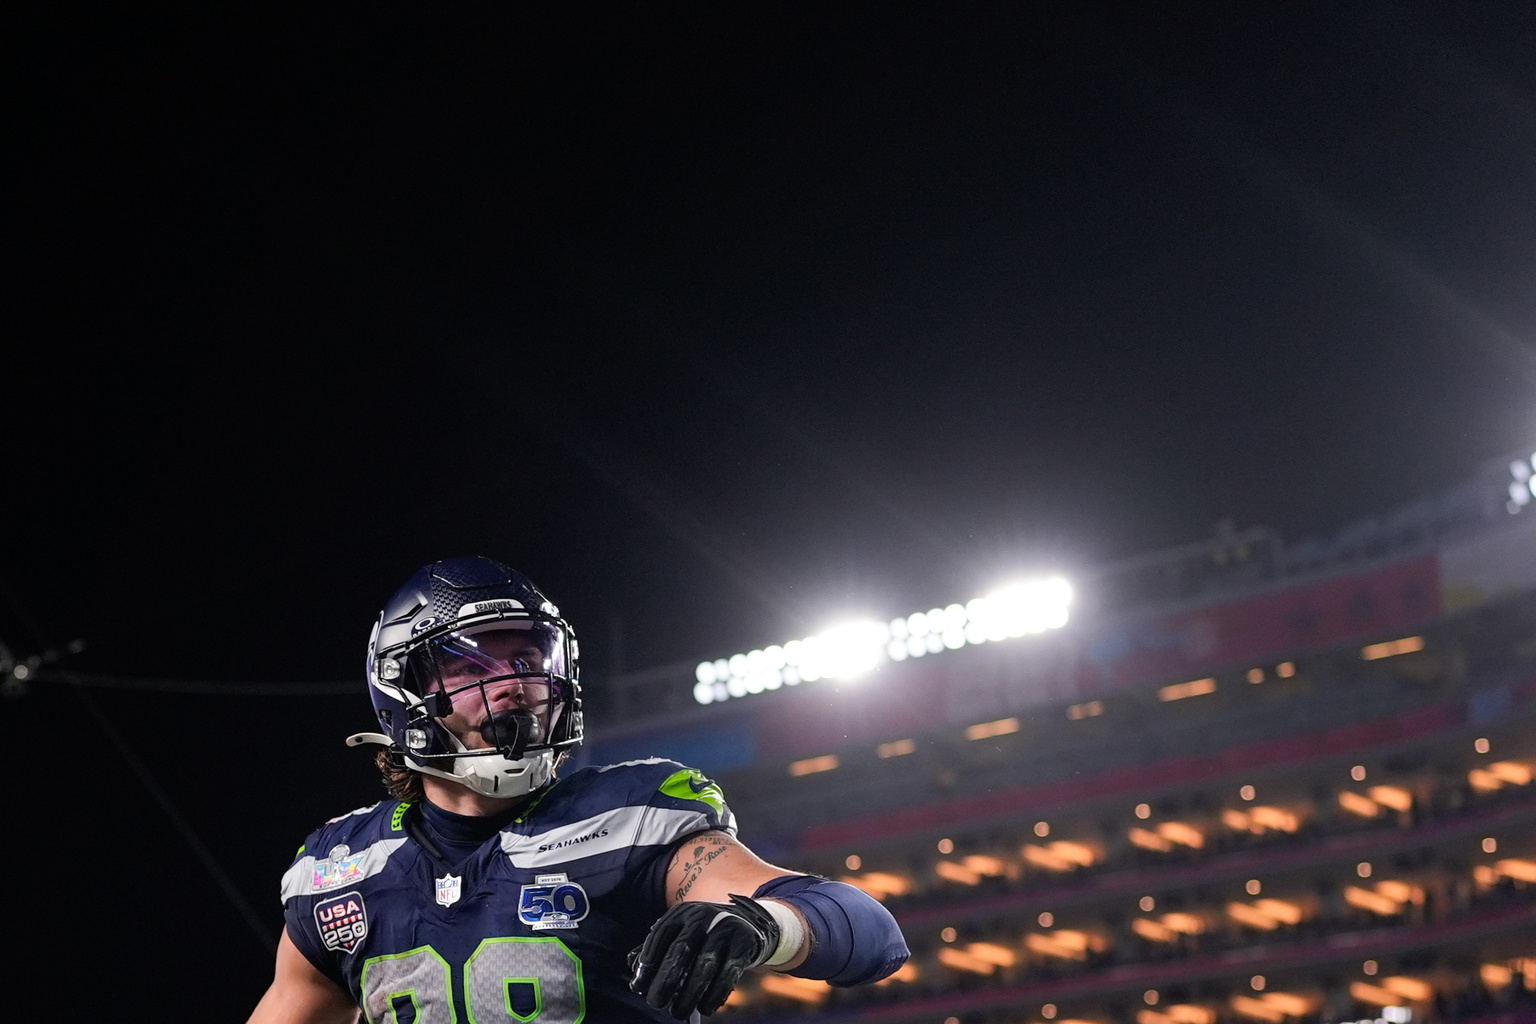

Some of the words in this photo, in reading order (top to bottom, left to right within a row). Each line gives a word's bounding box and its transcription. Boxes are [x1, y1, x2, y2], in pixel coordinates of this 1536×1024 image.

[474, 600, 513, 613] SEAHAWKS
[537, 828, 609, 853] SEAHAWKS
[675, 866, 703, 902] Reva's
[704, 845, 727, 865] Rose
[439, 889, 457, 900] NFL
[519, 884, 590, 924] 50
[318, 900, 361, 923] USA
[324, 920, 365, 948] 250
